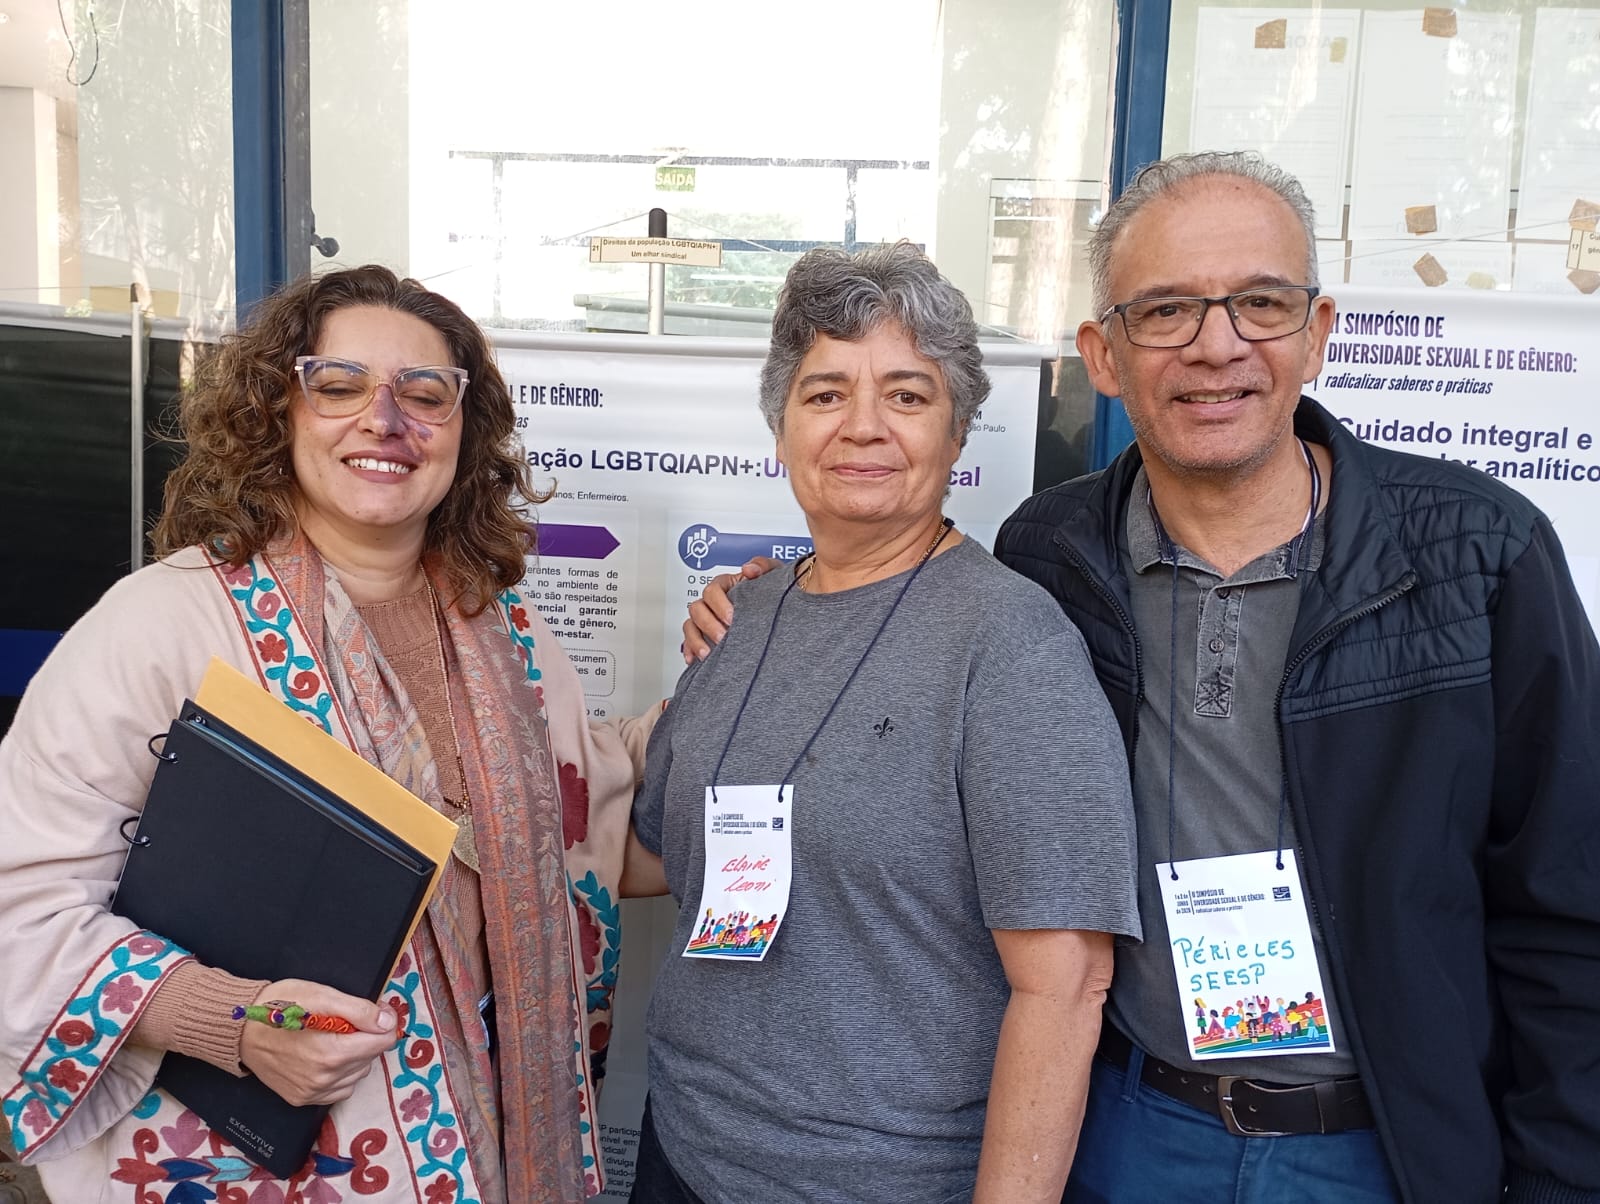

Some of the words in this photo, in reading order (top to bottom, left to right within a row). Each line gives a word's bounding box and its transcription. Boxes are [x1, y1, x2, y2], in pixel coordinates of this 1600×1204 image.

[655, 170, 695, 185] SAÍDA
[1344, 310, 1420, 337] SIMPÓSIO
[1424, 316, 1445, 338] DE
[1327, 342, 1422, 366] DIVERSIDADE
[1426, 346, 1480, 369] SEXUAL
[1484, 349, 1493, 369] E
[1496, 349, 1515, 370] DE
[1518, 347, 1577, 373] GÊNERO:
[1325, 372, 1387, 390] radicalizar
[1388, 375, 1434, 392] saberes
[1435, 380, 1444, 392] e
[1443, 378, 1493, 396] práticas
[519, 385, 527, 404] E
[531, 385, 547, 405] DE
[550, 383, 604, 408] GÊNERO:
[983, 424, 1006, 433] Paulo
[1462, 422, 1568, 453] integral
[1577, 433, 1593, 450] e
[577, 491, 629, 502] Enfermeiros.
[568, 568, 599, 578] formas
[606, 570, 618, 579] de
[688, 575, 696, 584] O
[556, 581, 599, 590] ambiente
[606, 583, 618, 591] de
[544, 592, 561, 600] são
[564, 593, 618, 604] respeitados
[687, 589, 698, 597] na
[579, 607, 618, 616] garantir
[563, 617, 575, 626] de
[580, 618, 617, 629] gênero,
[552, 630, 594, 640] m-estar.
[595, 667, 607, 676] de
[594, 708, 606, 717] de
[1190, 963, 1265, 992] SEESP
[229, 1116, 275, 1154] EXECUTIVE
[606, 1157, 634, 1168] divulga
